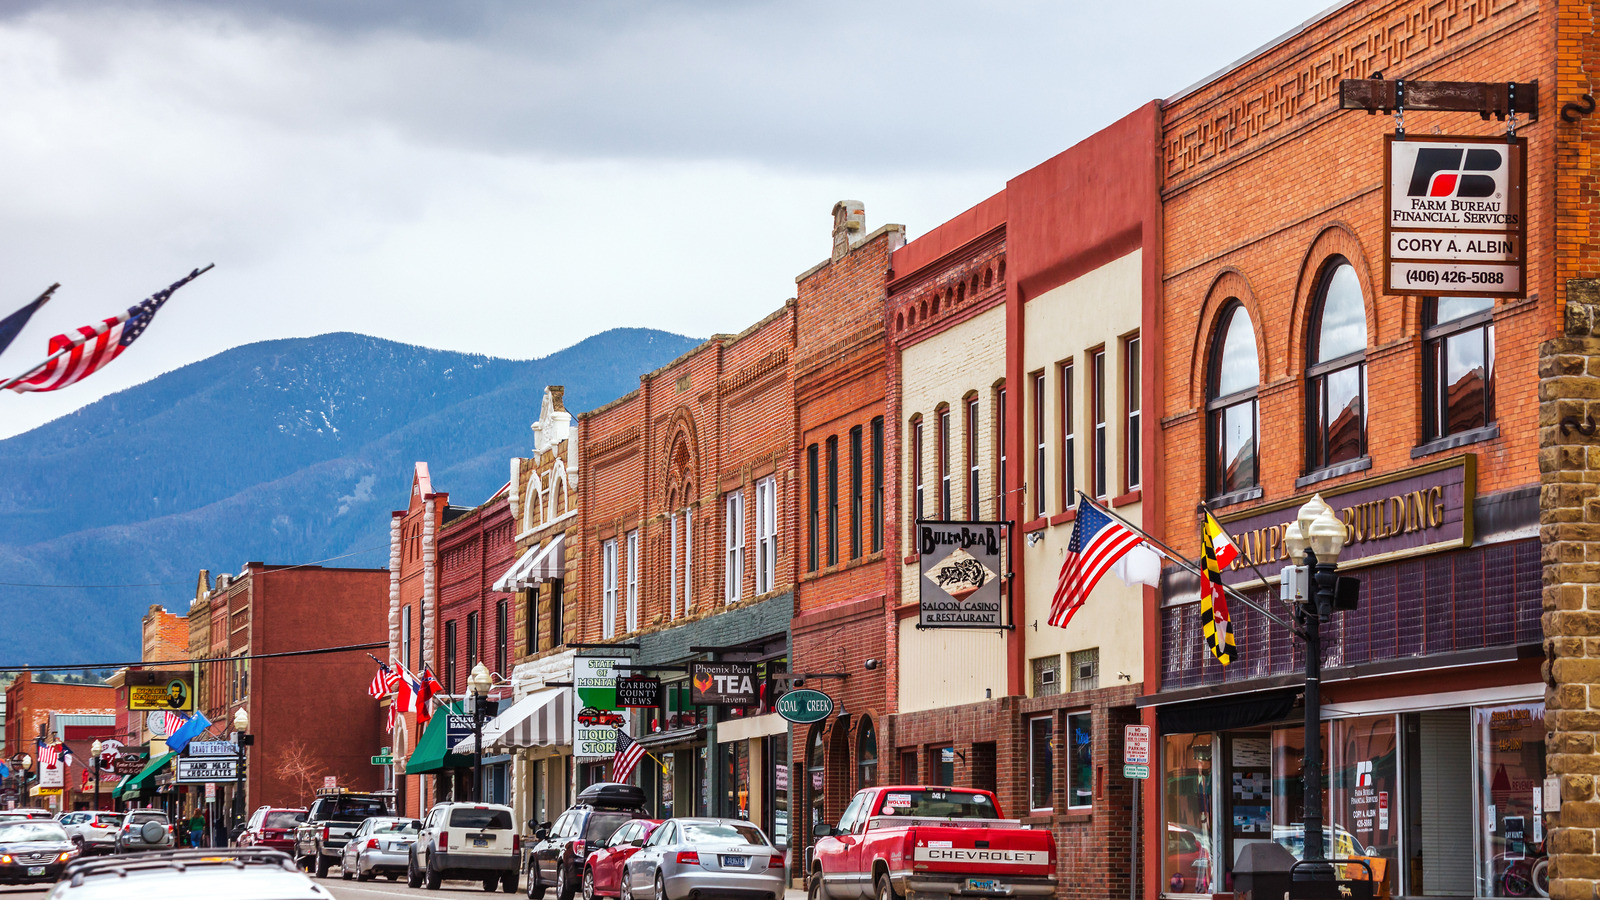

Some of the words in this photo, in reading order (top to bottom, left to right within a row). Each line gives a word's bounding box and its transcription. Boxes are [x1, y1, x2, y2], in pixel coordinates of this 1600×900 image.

[1411, 199, 1446, 211] FARM
[1451, 200, 1501, 212] BUREAU
[1393, 210, 1459, 222] FINANCIAL
[1464, 212, 1518, 224] SERVICES
[1397, 239, 1442, 252] CORY
[1447, 240, 1461, 252] A.
[1466, 240, 1513, 254] ALBIN
[1406, 270, 1439, 285] (406)
[1441, 271, 1504, 284] 426-5088
[1342, 486, 1443, 547] BUILDING
[964, 602, 999, 611] CASINO
[936, 614, 996, 622] RESTAURANT
[695, 665, 729, 674] Phoenix
[732, 665, 753, 674] Pearl
[578, 678, 617, 686] MONTAN
[713, 675, 754, 694] TEA
[720, 695, 747, 704] Tavern
[780, 700, 798, 712] COAL
[806, 700, 829, 712] CREEK
[578, 730, 618, 741] LIQUO
[212, 762, 231, 770] MADE
[928, 850, 1036, 862] CHEVROLET
